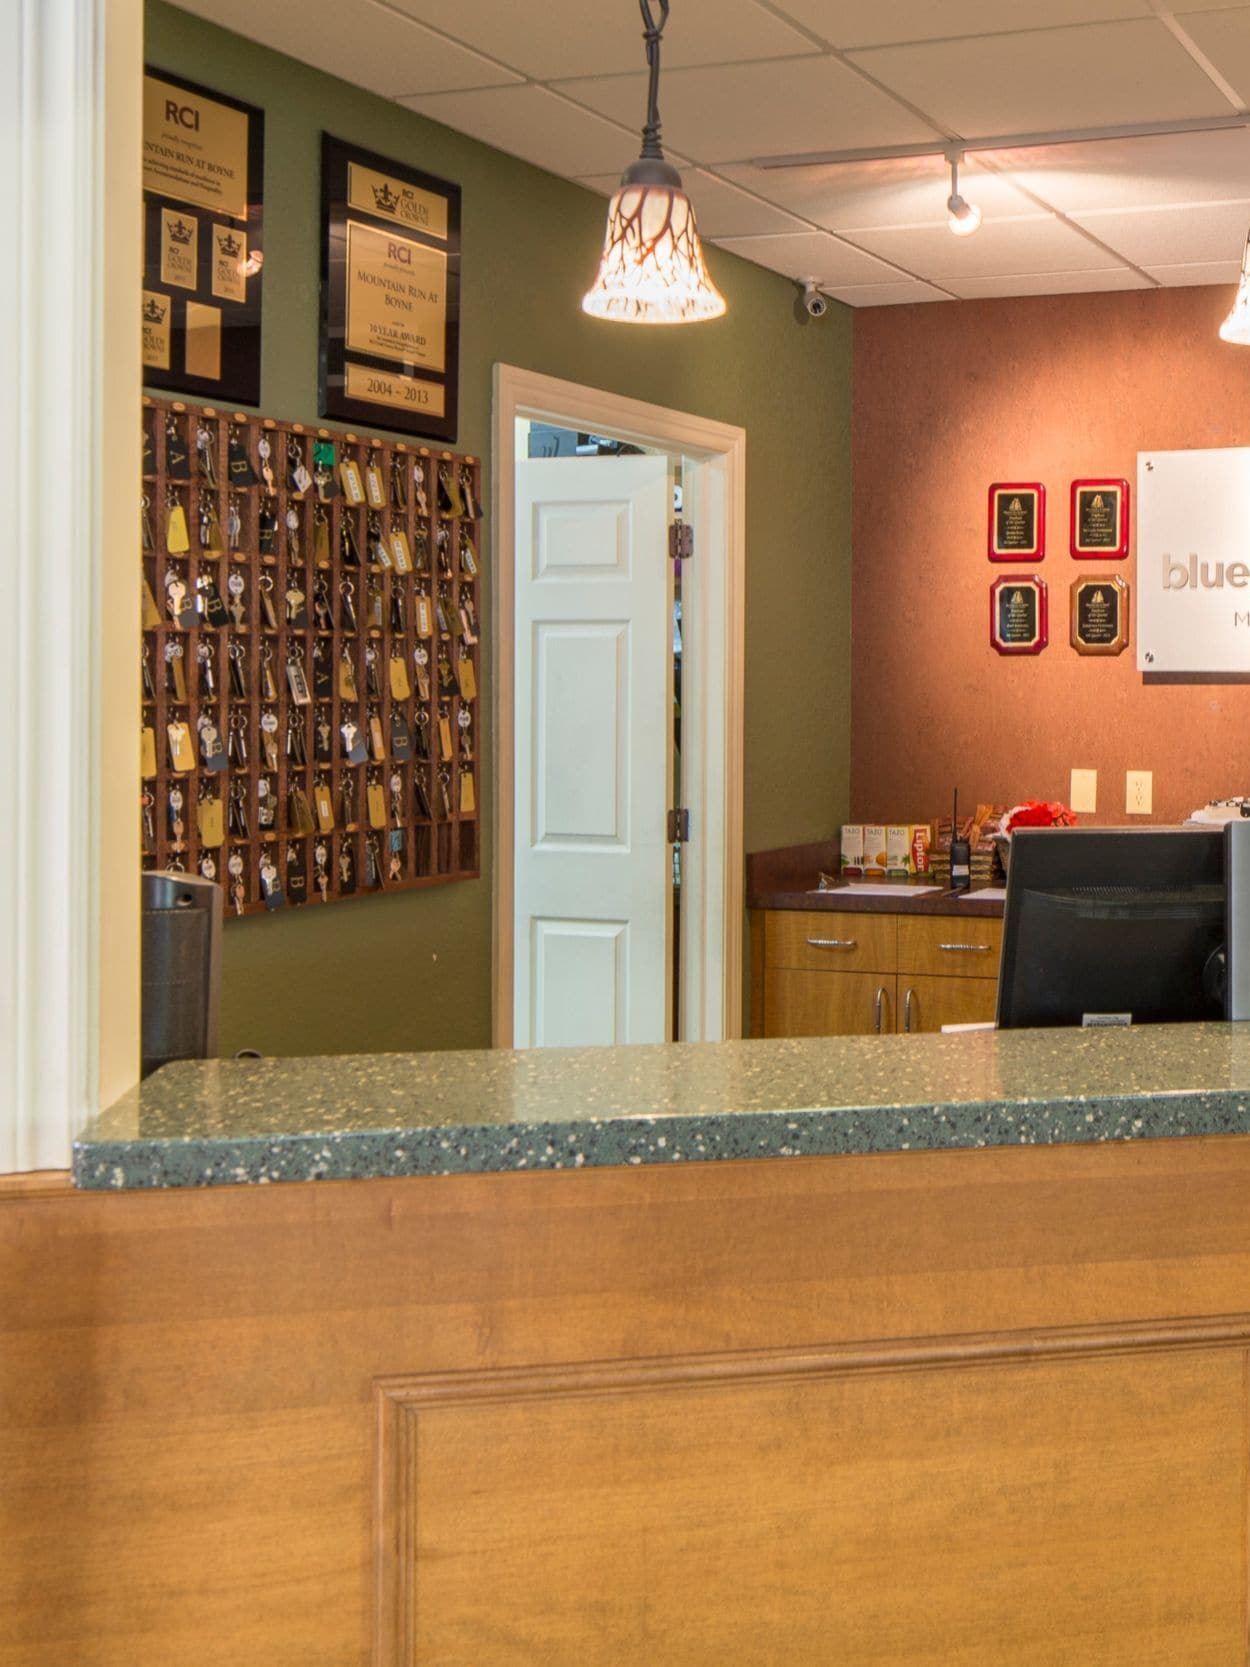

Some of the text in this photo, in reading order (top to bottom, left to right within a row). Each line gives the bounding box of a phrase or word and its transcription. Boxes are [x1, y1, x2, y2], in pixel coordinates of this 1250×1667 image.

[165, 99, 200, 132] RCI
[143, 141, 175, 159] NTAIN
[176, 150, 194, 166] RUN
[196, 159, 206, 169] AT
[207, 162, 234, 179] BOYNE
[388, 241, 412, 265] RCI
[357, 268, 406, 294] MOUNTAIN
[408, 284, 426, 301] RUN
[427, 291, 439, 304] AT
[384, 293, 413, 312] BOYNE
[378, 325, 398, 338] YEAR
[400, 330, 427, 346] AWARD
[367, 377, 392, 396] 2004
[404, 385, 430, 404] 2013
